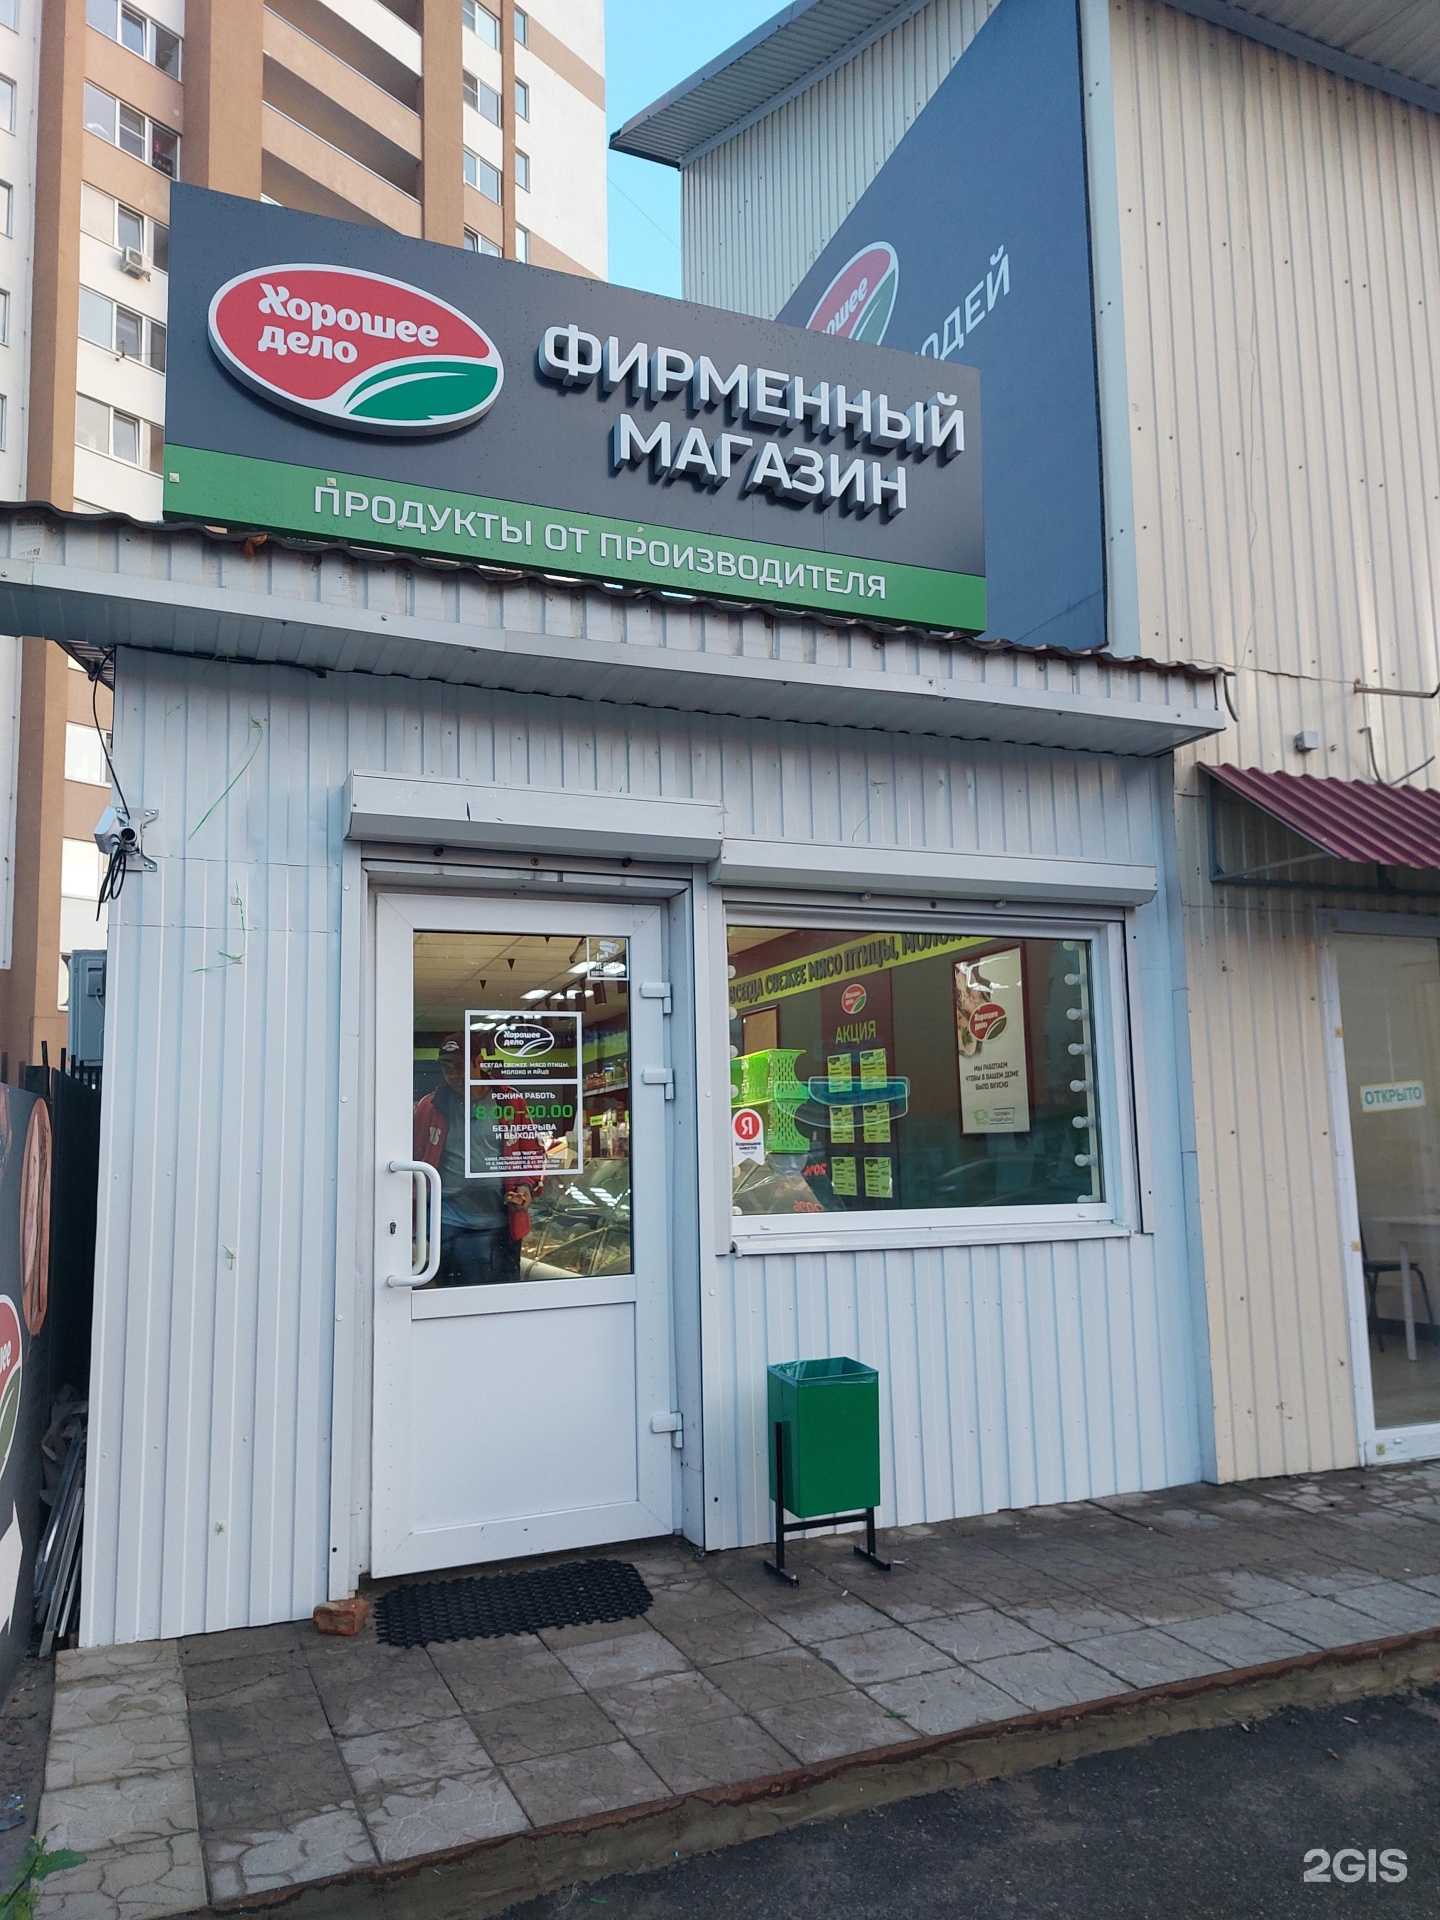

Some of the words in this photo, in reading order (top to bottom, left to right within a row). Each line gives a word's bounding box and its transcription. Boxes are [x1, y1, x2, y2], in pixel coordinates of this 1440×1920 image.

[258, 283, 439, 347] Хорошее
[257, 325, 358, 364] дело
[540, 324, 965, 453] ФИРМЕННЫЙ
[616, 413, 907, 510] МАГАЗИН
[314, 486, 532, 547] ПРОДУКТЫ
[544, 523, 589, 554] ОТ
[599, 532, 886, 600] ПРОИЗВОДИТЕЛЯ
[503, 1031, 541, 1039] Хорошее
[503, 1039, 525, 1047] дело
[835, 1019, 877, 1045] АКЦИЯ
[491, 1092, 523, 1100] РЕЖИМ
[1364, 1086, 1422, 1104] ОТКРЫТО
[492, 1124, 509, 1132] БЕЗ
[510, 1123, 557, 1132] ПЕРЕРЫВА
[741, 1116, 753, 1136] Я
